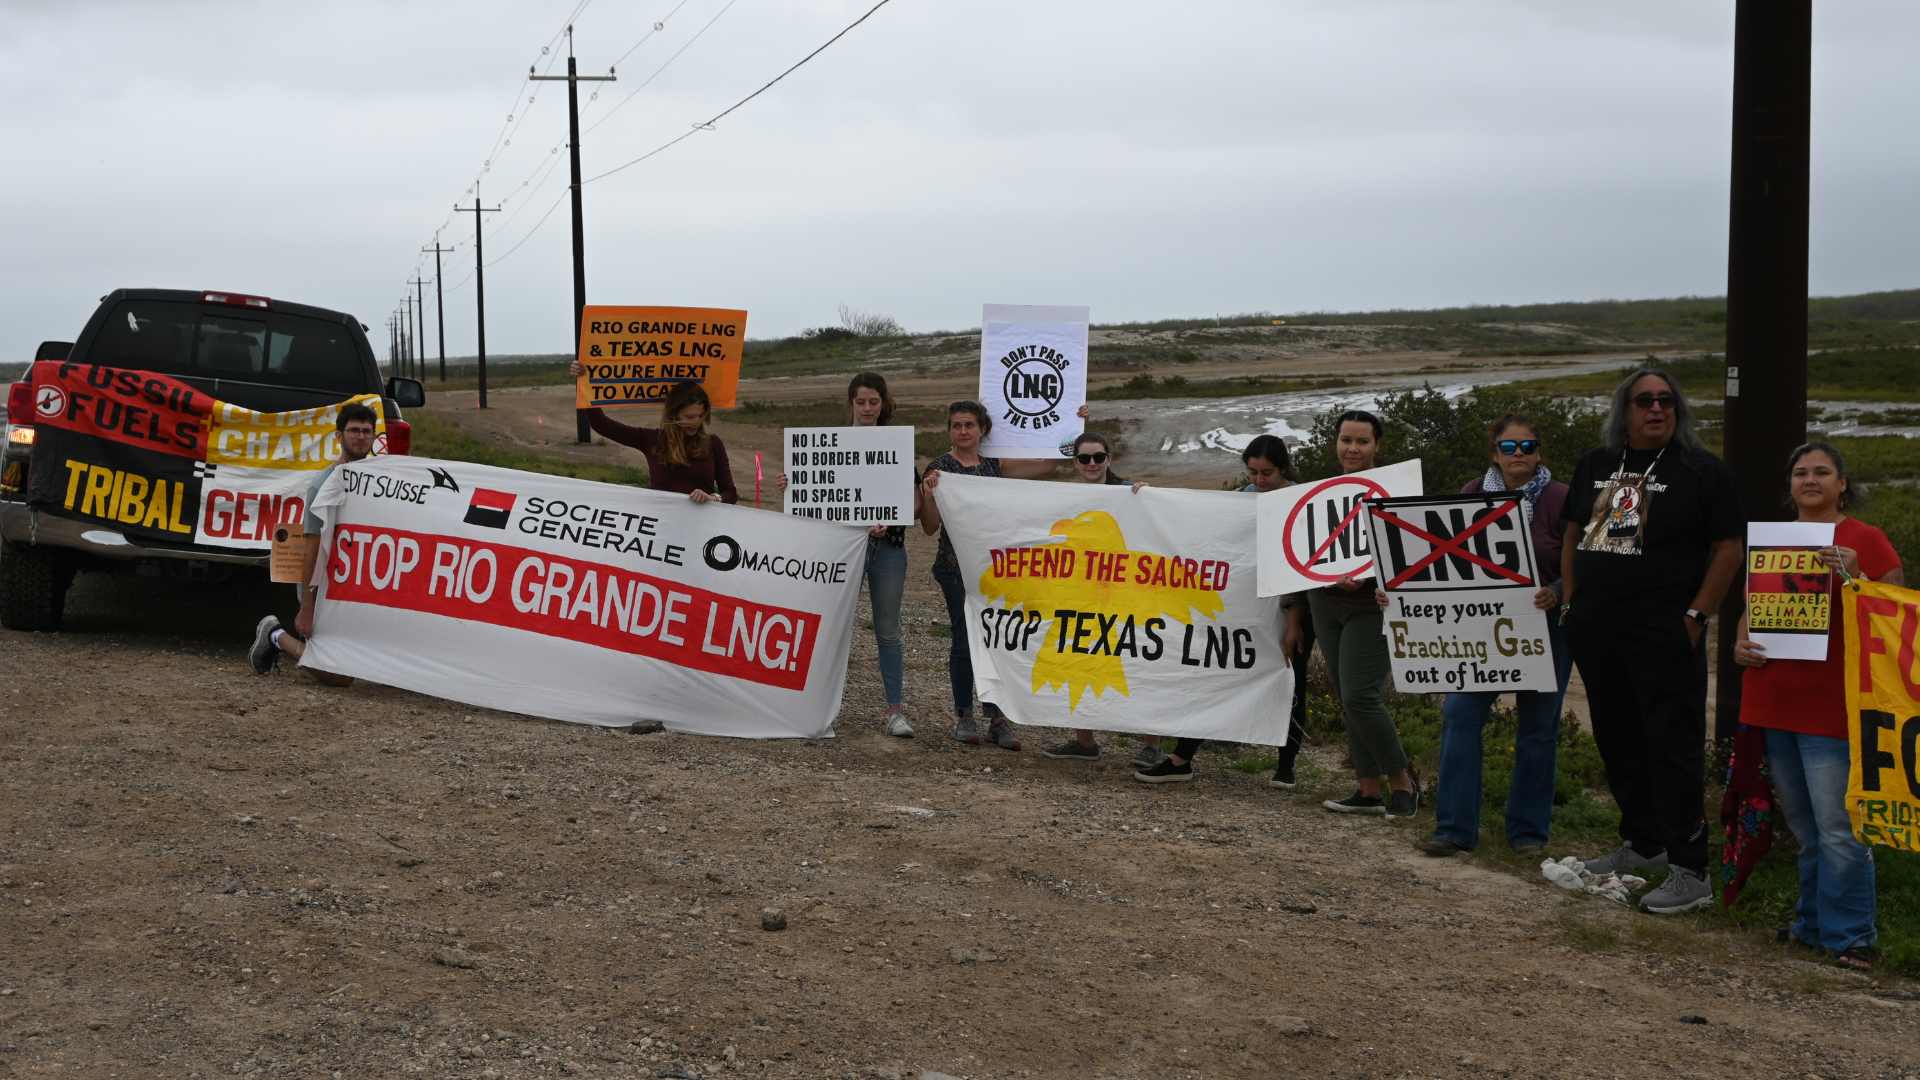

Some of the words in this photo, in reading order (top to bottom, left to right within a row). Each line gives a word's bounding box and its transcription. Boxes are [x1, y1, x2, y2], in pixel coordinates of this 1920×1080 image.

[591, 321, 623, 334] RIO
[628, 321, 697, 335] GRANDE
[702, 323, 736, 337] LNG
[590, 344, 602, 357] &
[608, 341, 673, 357] TEXAS
[680, 342, 726, 360] LNG,
[1000, 345, 1037, 369] DON'T
[1039, 345, 1070, 371] PASS
[586, 364, 656, 378] YOU'RE
[661, 364, 710, 378] NEXT
[592, 385, 617, 400] TO
[622, 384, 670, 399] VACA
[1011, 373, 1057, 399] LNG
[67, 392, 199, 449] FUELS
[1003, 409, 1028, 429] THE
[1033, 411, 1060, 429] GAS
[218, 430, 342, 462] CHANG
[792, 433, 808, 448] NO
[812, 433, 838, 448] I.C.E
[792, 452, 808, 466] NO
[812, 451, 860, 466] BORDER
[865, 450, 899, 465] WALL
[373, 475, 431, 504] SUISSE
[792, 470, 808, 485] NO
[812, 470, 835, 484] LNG
[64, 459, 192, 534] TRIBAL
[792, 489, 808, 503] NO
[812, 488, 850, 503] SPACE
[854, 488, 862, 502] X
[525, 497, 660, 537] SOCIETE
[827, 507, 850, 521] OUR
[854, 506, 898, 521] FUTURE
[518, 516, 686, 567] GENERALE
[1307, 492, 1371, 565] LNG
[1383, 505, 1520, 583] LNG
[740, 551, 847, 584] MACQURIE
[990, 548, 1076, 579] DEFEND
[1084, 550, 1129, 583] THE
[1135, 556, 1230, 592] SACRED
[1754, 554, 1825, 569] BIDEN
[334, 529, 421, 590] STOP
[428, 543, 497, 604] RIO
[511, 556, 692, 647] GRANDE
[701, 601, 806, 673] LNG!
[1398, 597, 1447, 624] keep
[1452, 600, 1505, 622] your
[1750, 594, 1814, 604] DECLARE
[1752, 606, 1827, 618] CLIMATE
[1751, 618, 1827, 628] EMERGENCY
[980, 607, 1042, 652] STOP
[1054, 609, 1167, 661] TEXAS
[1181, 623, 1256, 670] LNG
[1390, 620, 1488, 663] Fracking
[1494, 618, 1545, 657] Gas
[1405, 664, 1438, 684] out
[1445, 662, 1467, 690] of
[1473, 663, 1521, 684] here
